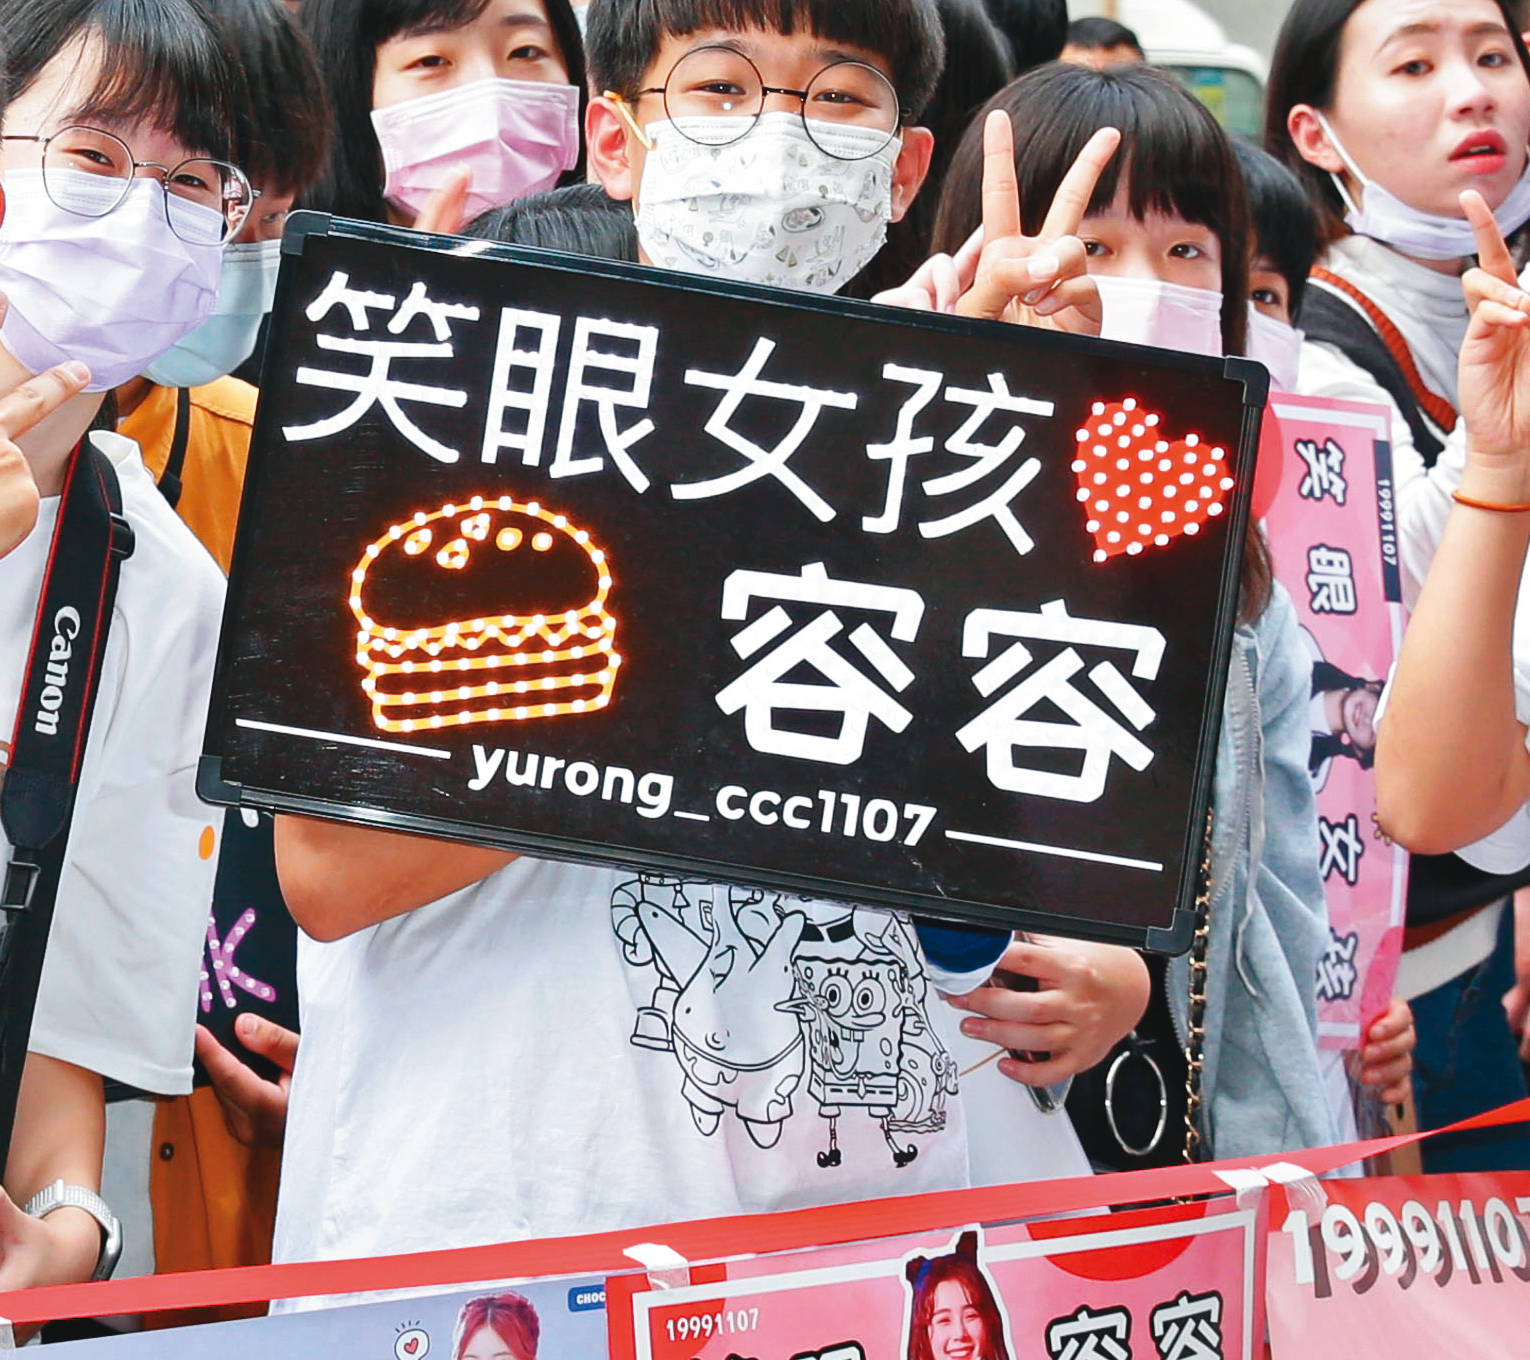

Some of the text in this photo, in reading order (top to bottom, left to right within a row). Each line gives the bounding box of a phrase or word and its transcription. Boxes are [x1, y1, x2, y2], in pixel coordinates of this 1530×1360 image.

[280, 267, 1057, 557] 笑眼女孩
[1294, 435, 1359, 618] 笑眼
[34, 605, 82, 736] Canon
[712, 560, 1170, 804] 容容
[466, 742, 938, 849] yurong_ccc1107
[665, 1305, 760, 1342] 19991107
